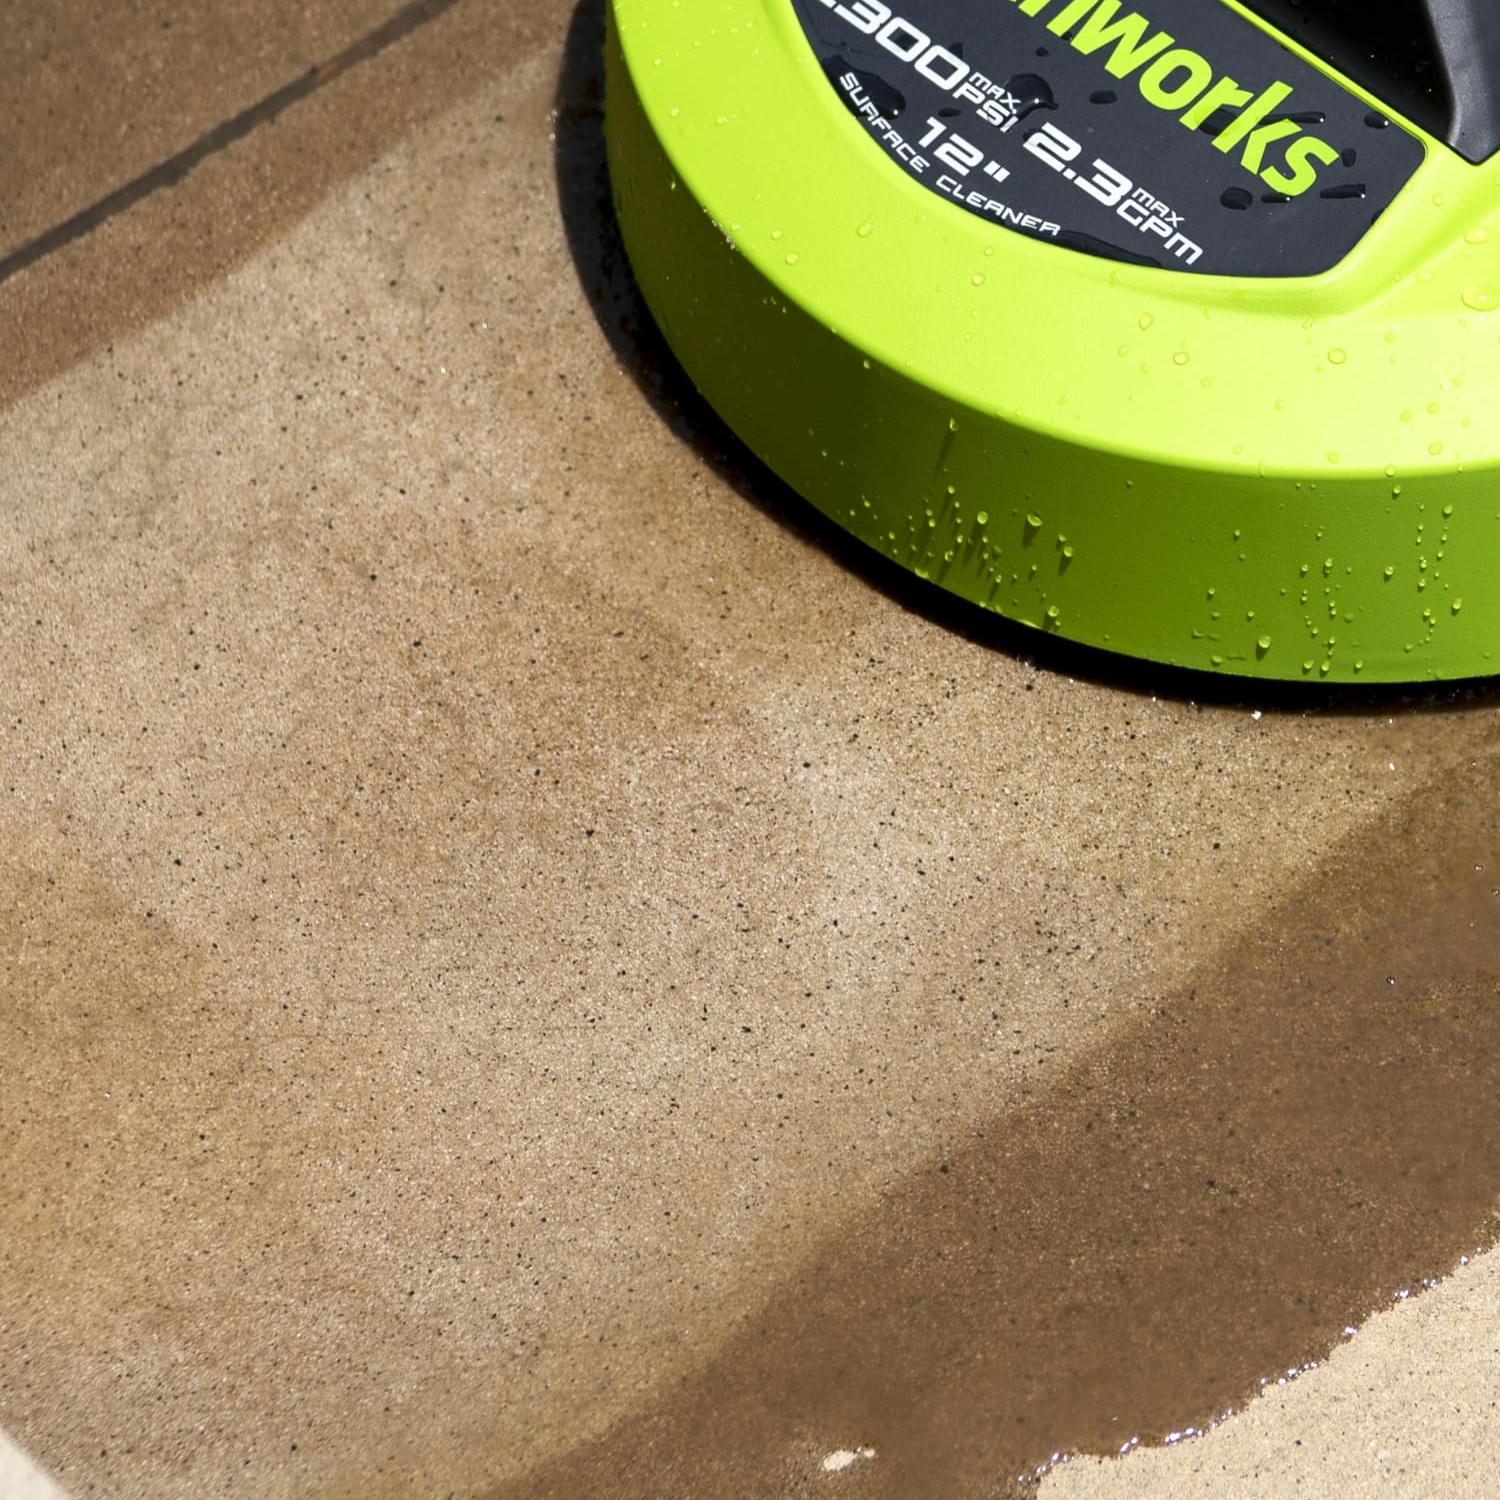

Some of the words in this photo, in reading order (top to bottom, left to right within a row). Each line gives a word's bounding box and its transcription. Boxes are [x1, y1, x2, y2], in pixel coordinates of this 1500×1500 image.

[952, 82, 1018, 132] PSI
[968, 72, 1021, 114] MAX
[839, 72, 930, 173] SURFACE
[935, 175, 1061, 236] CLEANER
[918, 116, 1010, 182] 12"
[1022, 122, 1133, 207] 2.3
[1116, 199, 1203, 265] GPM
[1131, 188, 1185, 228] MAX
